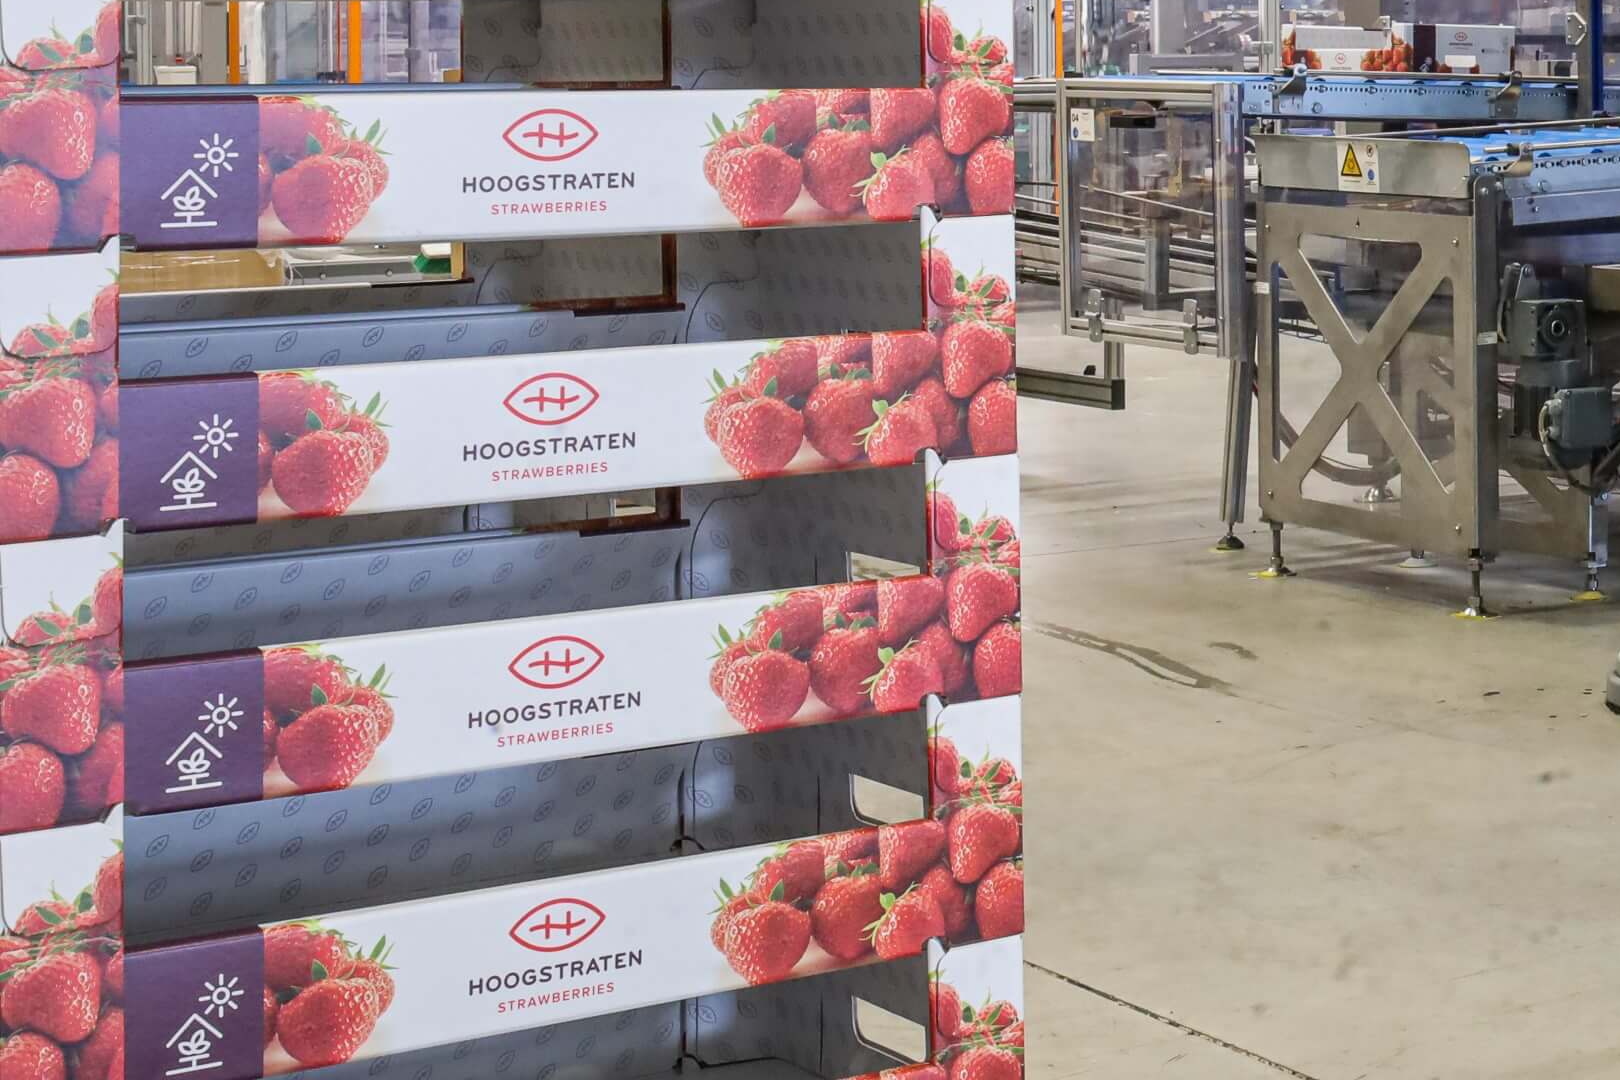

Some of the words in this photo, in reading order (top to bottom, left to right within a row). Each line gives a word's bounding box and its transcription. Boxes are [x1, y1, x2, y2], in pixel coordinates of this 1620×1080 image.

[462, 171, 635, 193] HOOGSTRATEN
[490, 200, 608, 216] STRAWBERRIES
[463, 431, 636, 462] HOOGSTRATEN
[491, 461, 609, 483] STRAWBERRIES
[468, 690, 641, 729] HOOGSTRATEN
[497, 721, 614, 748] STRAWBERRIES
[468, 949, 643, 997] HOOGSTRATEN
[497, 981, 615, 1014] STRAWBERRIES
